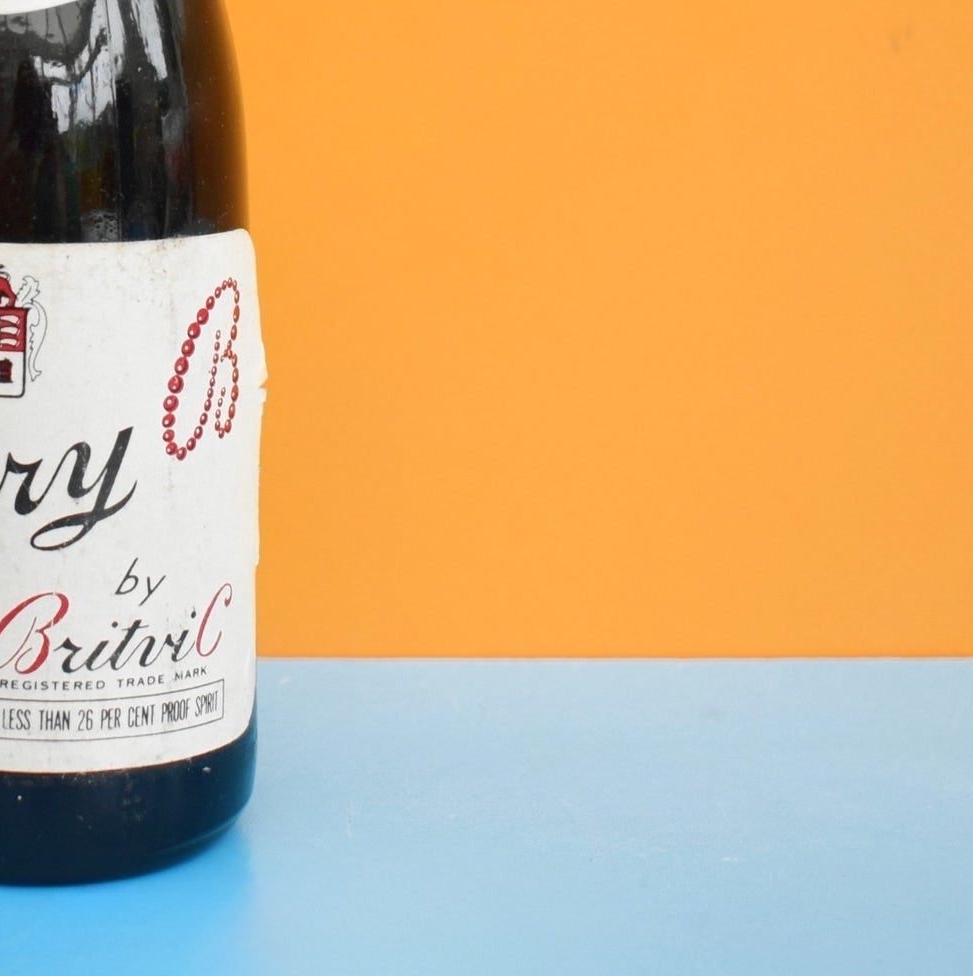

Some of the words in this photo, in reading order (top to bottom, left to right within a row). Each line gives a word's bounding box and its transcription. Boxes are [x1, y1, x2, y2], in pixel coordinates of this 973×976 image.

[114, 557, 166, 606] by
[0, 678, 107, 691] REGISTERED
[117, 674, 165, 689] TRADE
[174, 665, 208, 682] MARK
[2, 708, 32, 731] LESS
[39, 709, 71, 732] THAN
[77, 708, 94, 732] 26
[100, 707, 122, 730] PER
[127, 704, 156, 729] CENT
[161, 698, 192, 724] PROOF
[194, 690, 219, 718] SPIRIT
